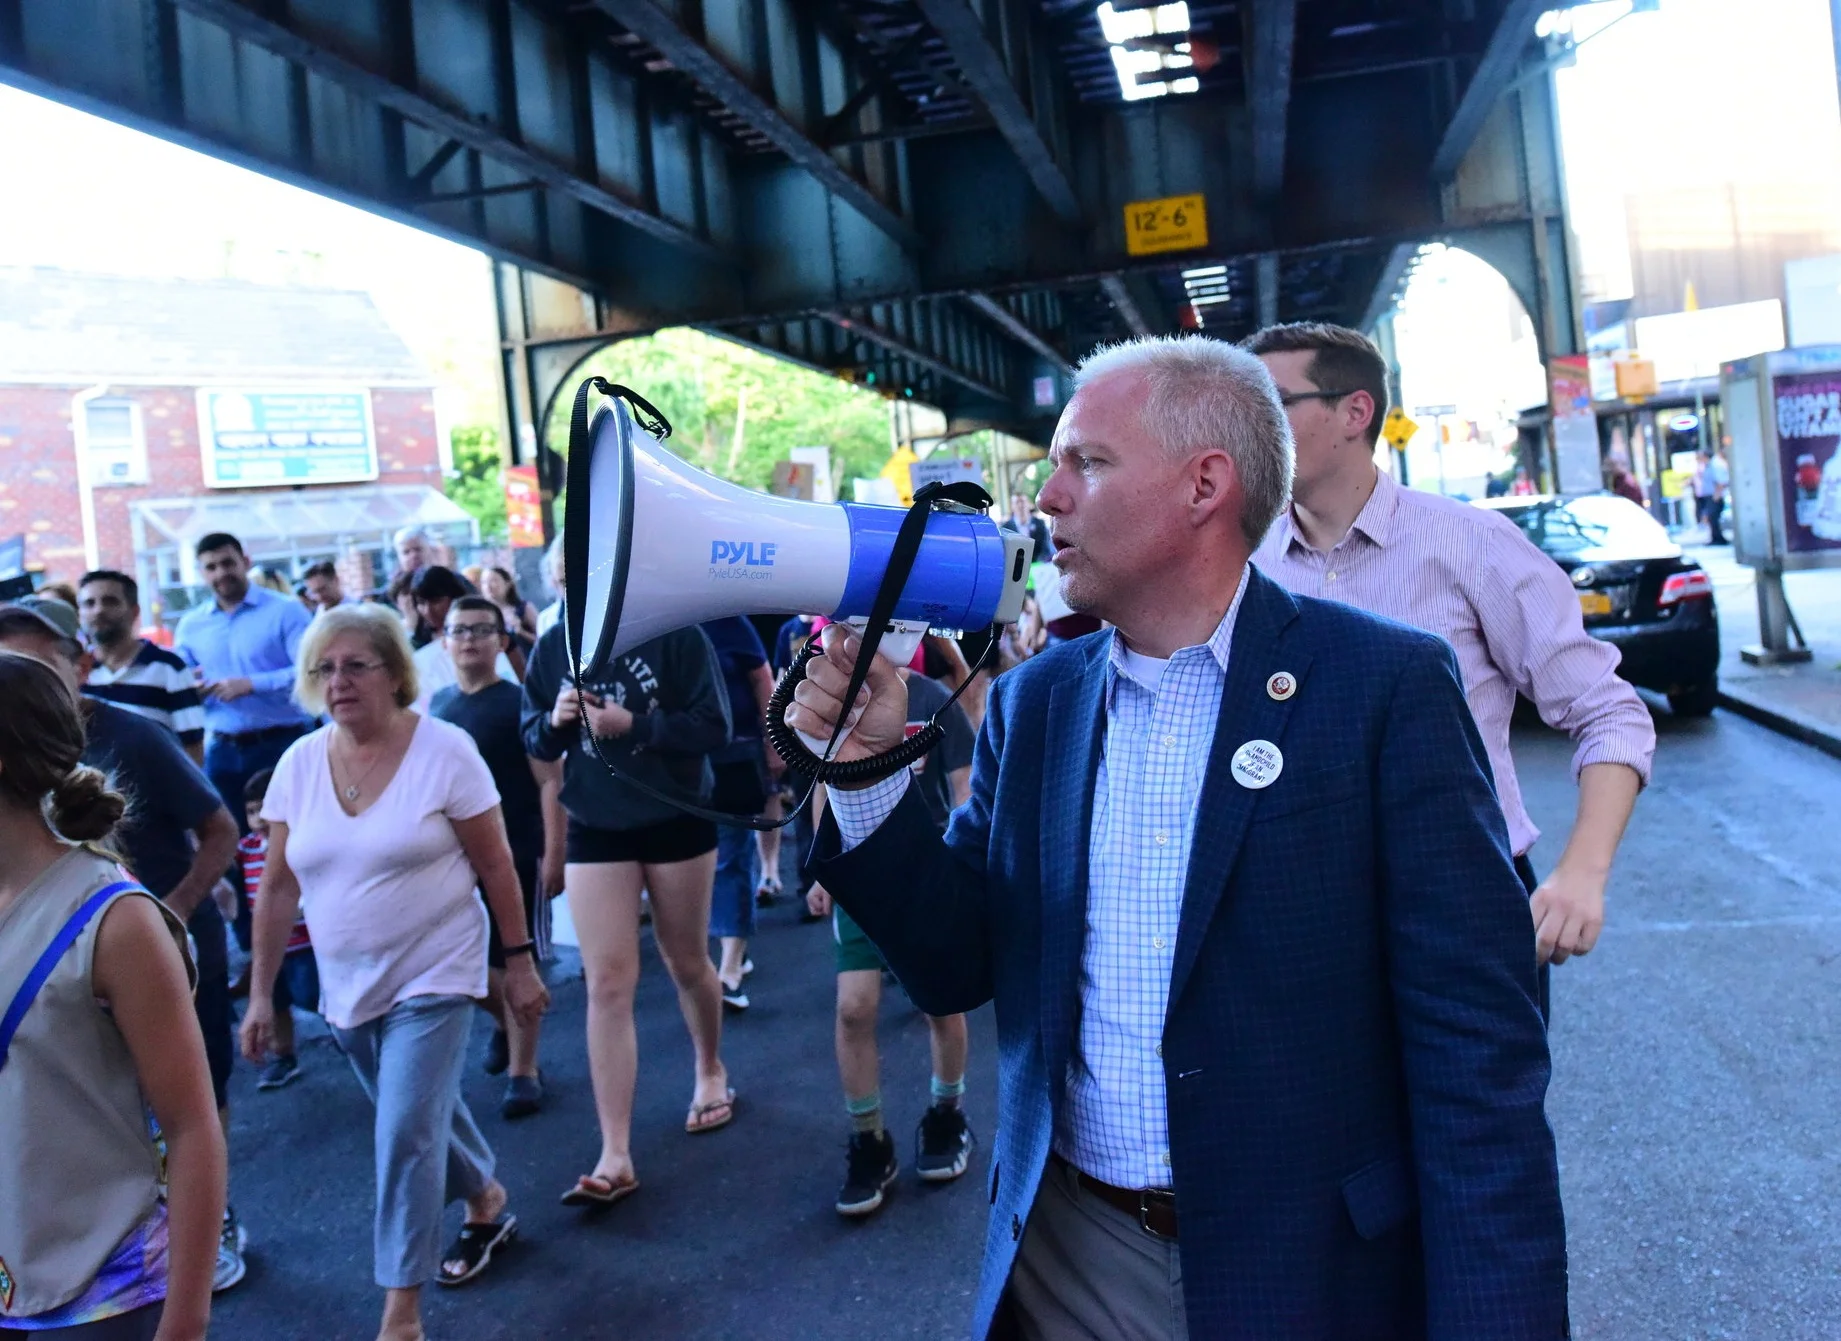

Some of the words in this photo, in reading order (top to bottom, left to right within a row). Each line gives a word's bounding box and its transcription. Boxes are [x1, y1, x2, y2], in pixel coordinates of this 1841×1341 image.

[710, 540, 776, 566] PYLE
[708, 567, 773, 581] PyleUSA.com
[1255, 747, 1265, 755] AM
[1264, 751, 1275, 761] THE
